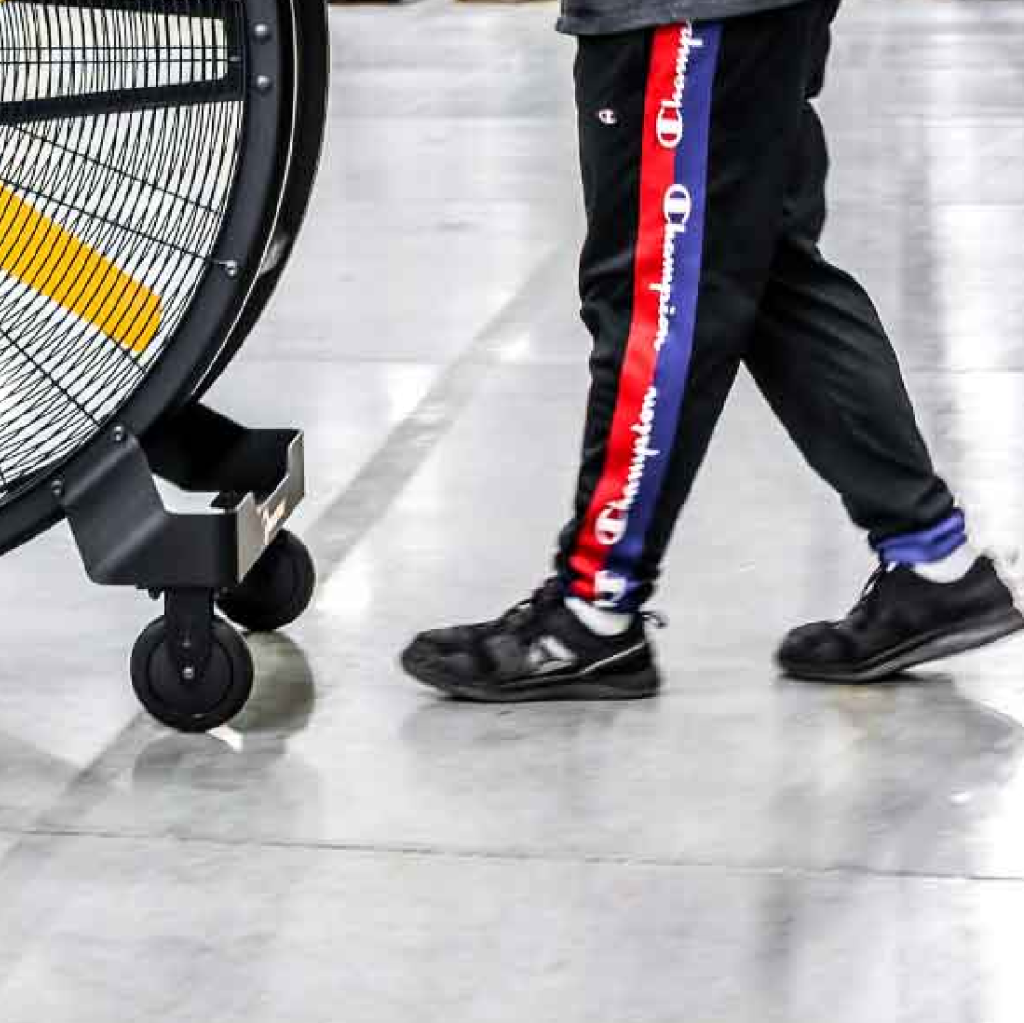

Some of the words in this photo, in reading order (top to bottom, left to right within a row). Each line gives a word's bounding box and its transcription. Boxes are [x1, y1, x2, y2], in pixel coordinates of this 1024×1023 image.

[656, 20, 704, 149] Champ
[647, 183, 693, 351] Champion
[595, 386, 660, 545] Champion
